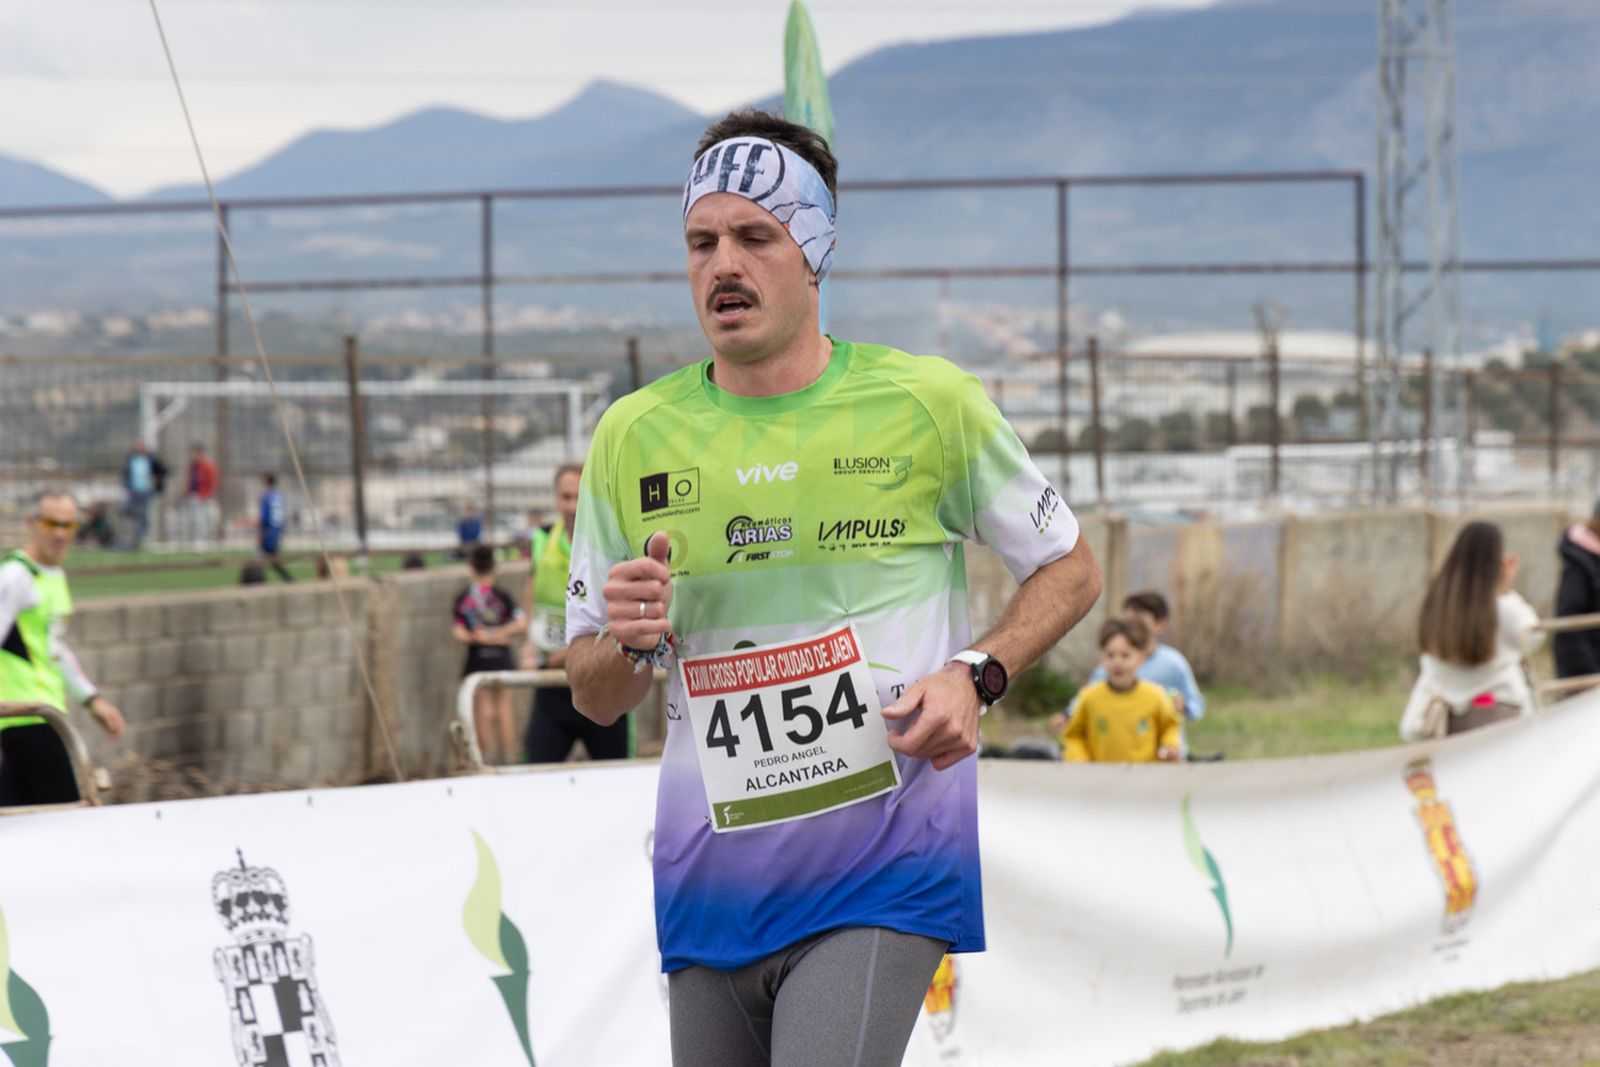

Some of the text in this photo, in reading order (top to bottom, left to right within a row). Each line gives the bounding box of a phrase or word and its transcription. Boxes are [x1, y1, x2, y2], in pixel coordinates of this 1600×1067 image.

[736, 461, 799, 486] vive
[729, 524, 793, 546] ARIAS
[709, 660, 738, 690] CROSS
[735, 654, 780, 685] POPULAR
[777, 648, 815, 678] CIUDAD
[814, 644, 831, 669] DE
[829, 633, 855, 665] JAEN
[706, 671, 868, 758] 4154
[754, 746, 827, 769] PEDRO ANGEL
[745, 757, 849, 792] ALCANTARA
